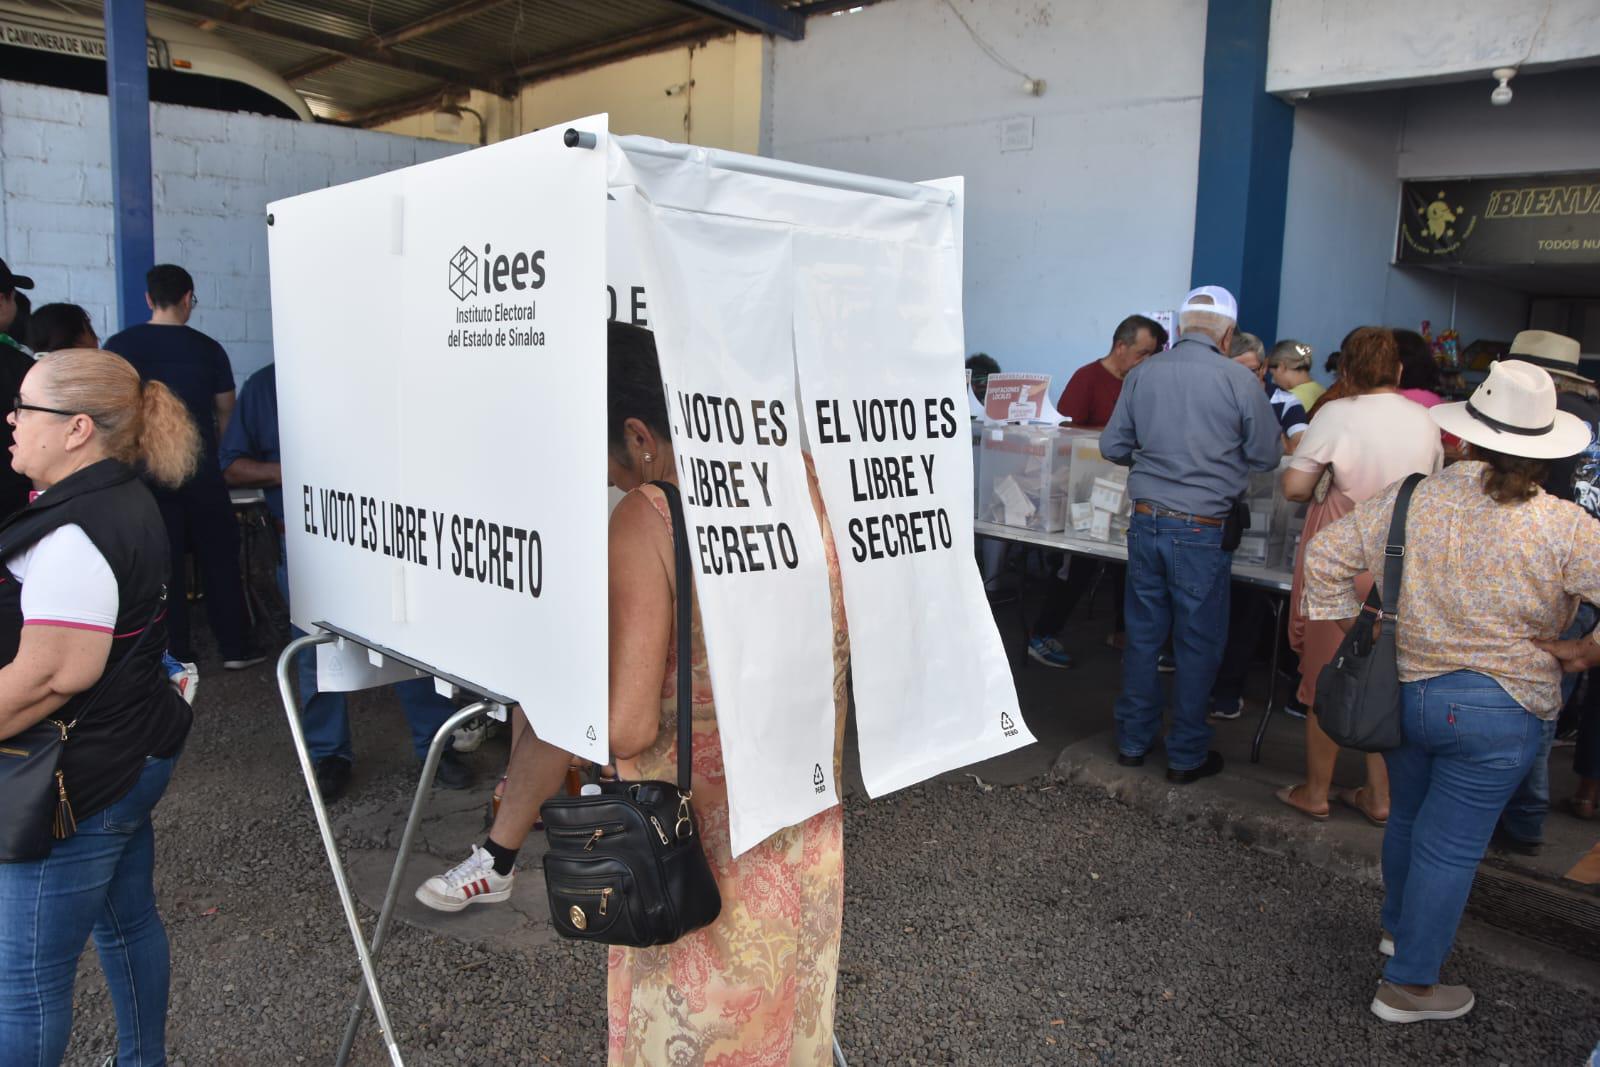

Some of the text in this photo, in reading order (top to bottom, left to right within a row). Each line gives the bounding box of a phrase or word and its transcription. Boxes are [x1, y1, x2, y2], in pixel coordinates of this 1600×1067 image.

[7, 27, 65, 49] CAMIONERA
[66, 38, 78, 53] DE
[484, 243, 546, 294] iees
[1538, 240, 1579, 250] TODOS
[456, 300, 536, 323] Instituto Electoral
[448, 326, 545, 347] del Estado de Sinaloa
[678, 390, 745, 446] VOTO
[751, 399, 788, 447] ES
[816, 397, 957, 444] EL VOTO ES
[750, 461, 772, 507] Y
[849, 453, 935, 502] LIBRE Y
[303, 484, 543, 599] EL VOTO ES LIBRE Y SECRETO
[696, 522, 799, 576] ECRETO
[848, 507, 953, 563] SECRETO
